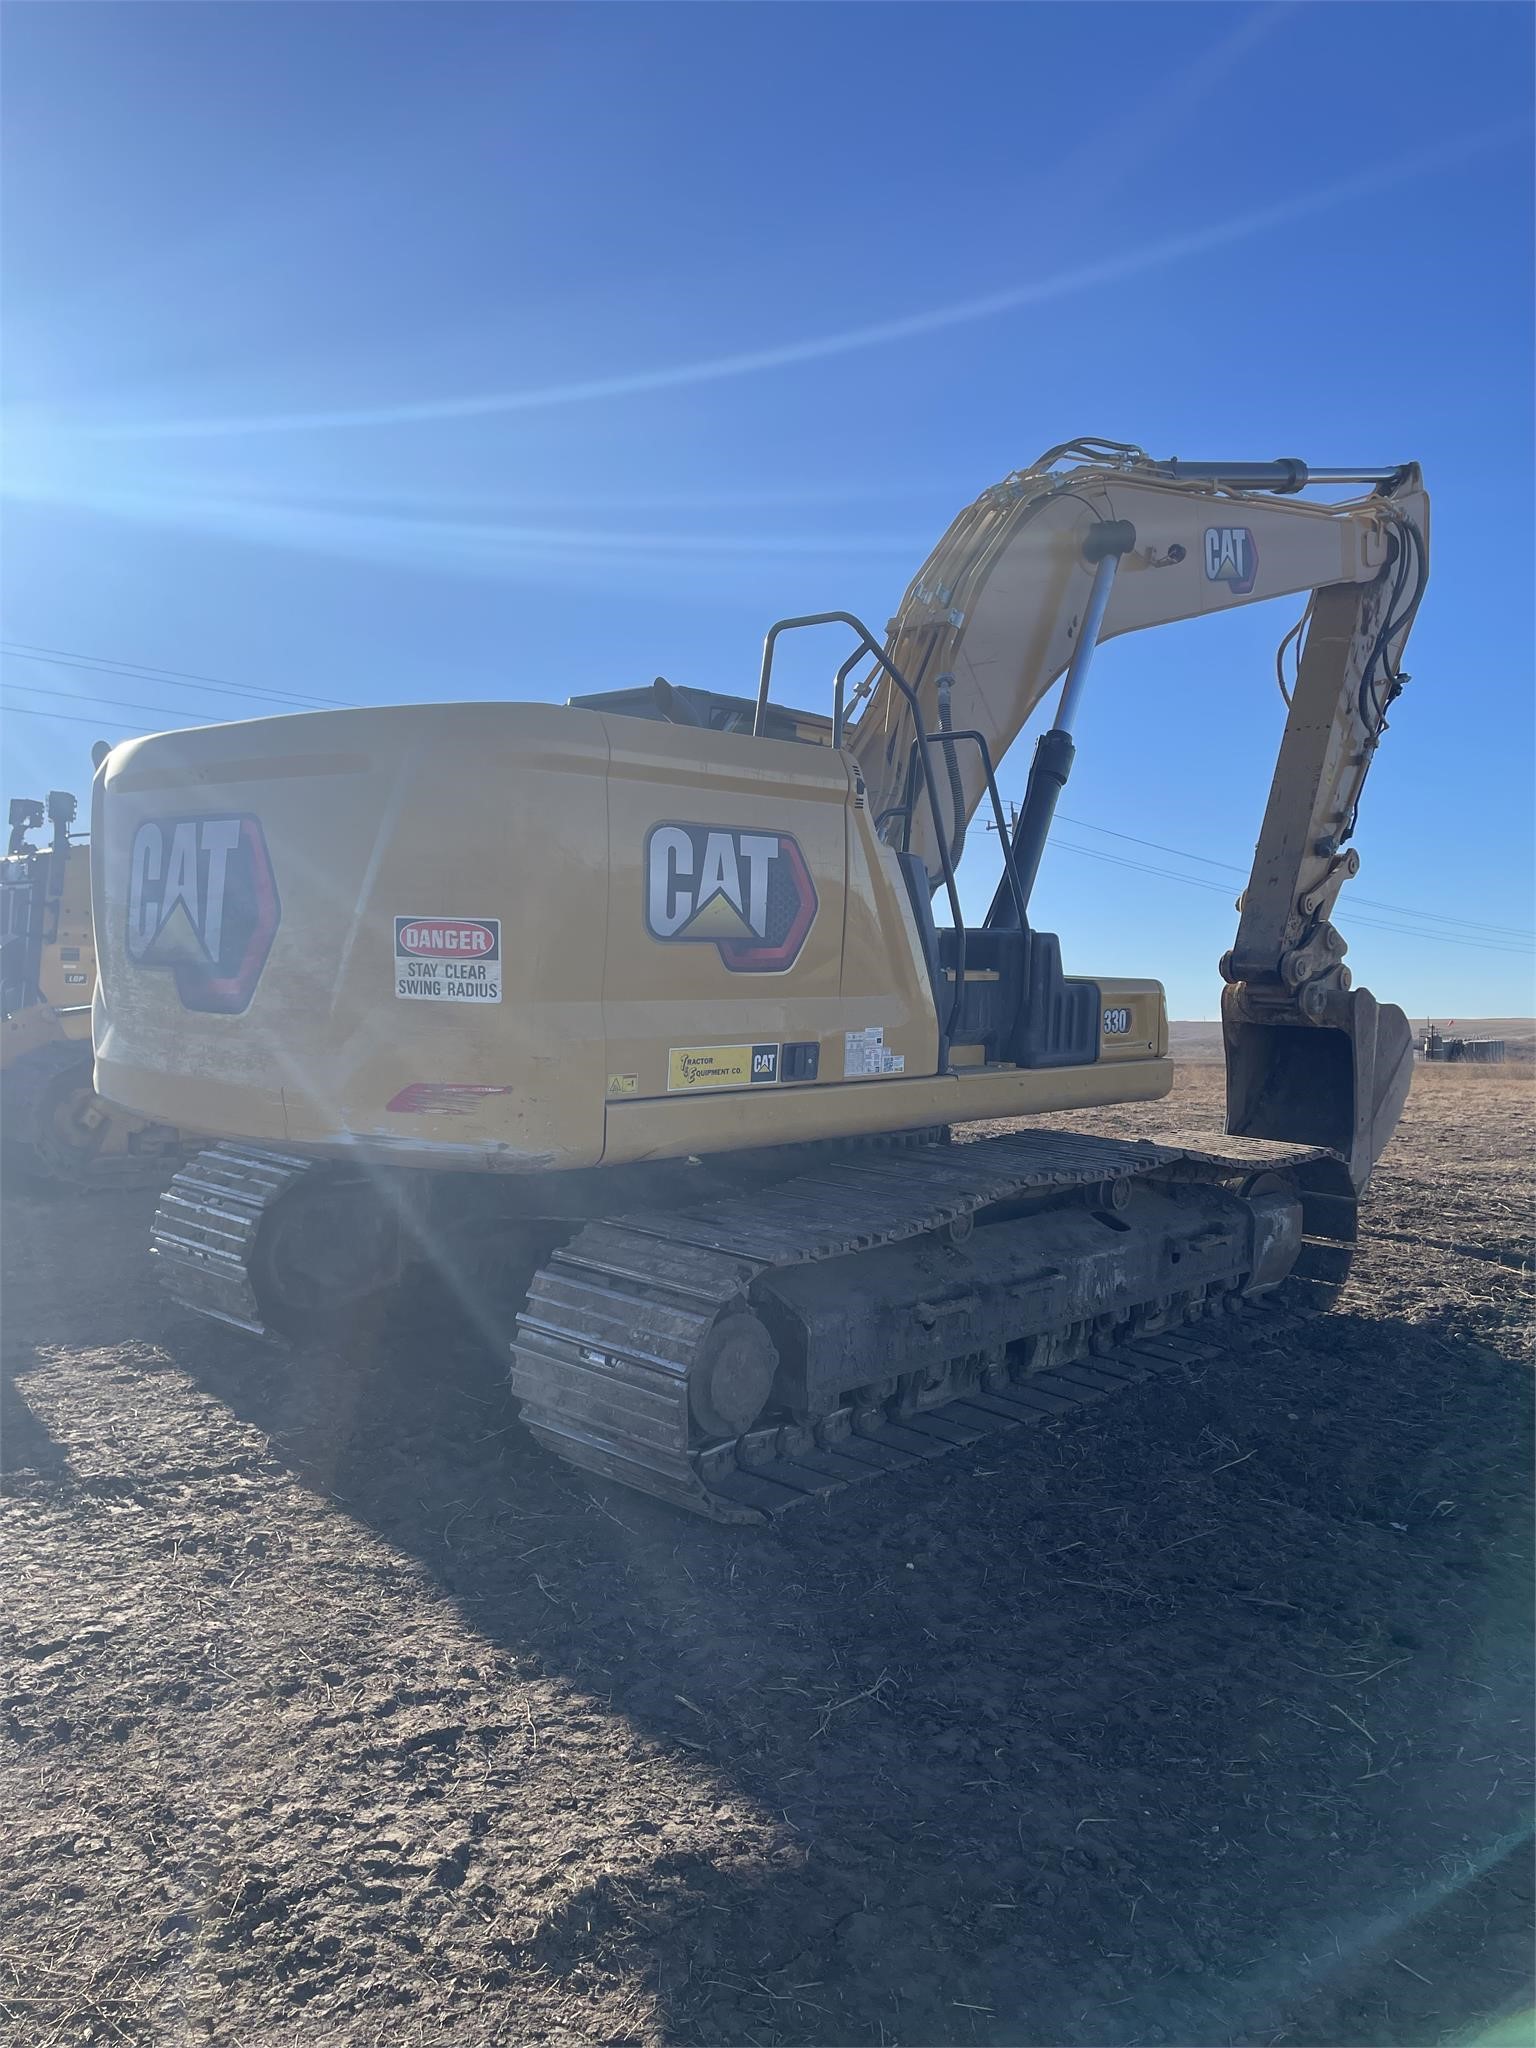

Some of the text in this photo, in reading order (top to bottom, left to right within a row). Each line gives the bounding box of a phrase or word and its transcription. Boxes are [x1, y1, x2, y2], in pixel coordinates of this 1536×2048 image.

[1205, 528, 1246, 579] CAT
[129, 819, 242, 963] CAT
[649, 826, 779, 938] CAT
[405, 928, 487, 950] DANGER
[408, 962, 486, 980] STAY CLEAR
[399, 979, 497, 998] SWING RADIUS
[1104, 1010, 1126, 1033] 330
[754, 1054, 775, 1073] CAT
